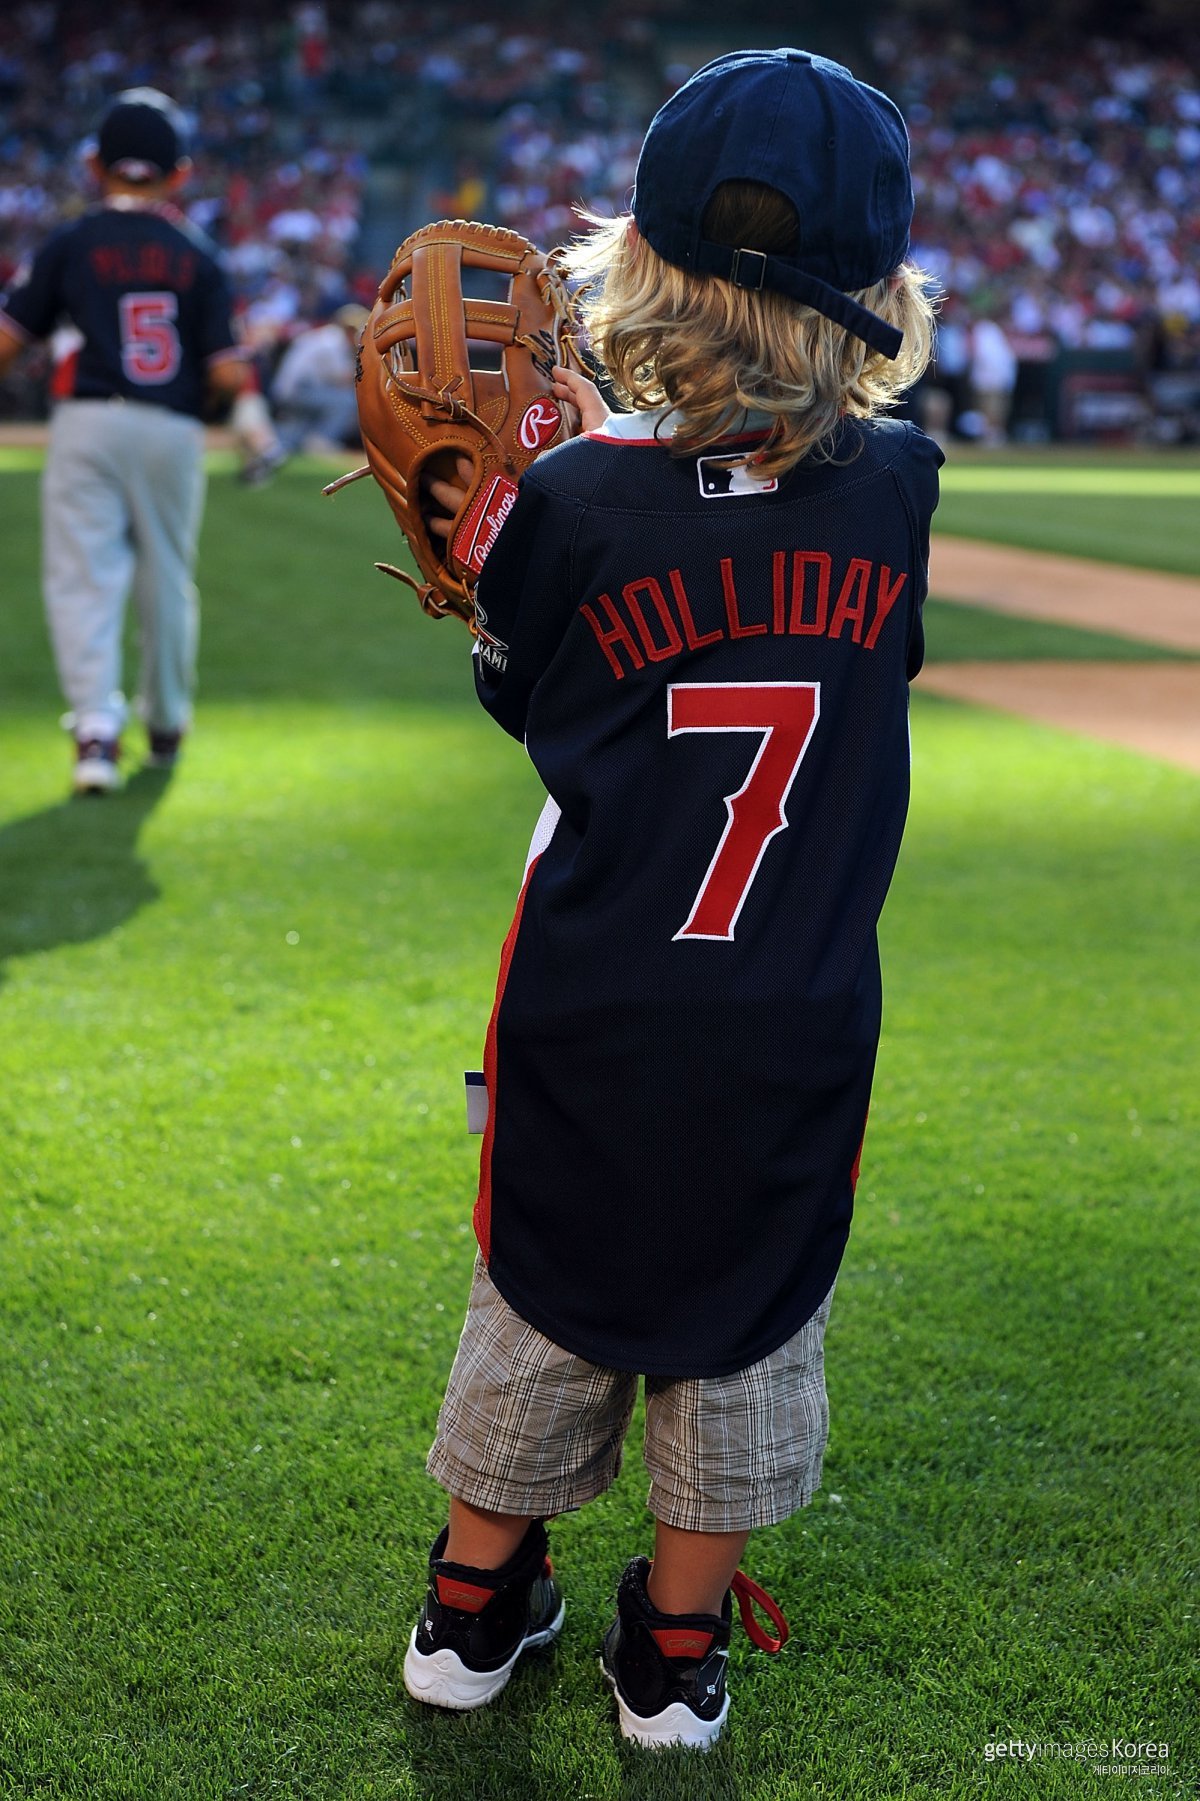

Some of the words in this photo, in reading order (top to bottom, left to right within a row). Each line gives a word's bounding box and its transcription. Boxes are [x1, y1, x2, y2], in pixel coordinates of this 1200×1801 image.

[119, 291, 181, 385] 5
[579, 550, 907, 680] HOLLIDAY
[667, 682, 820, 941] 7
